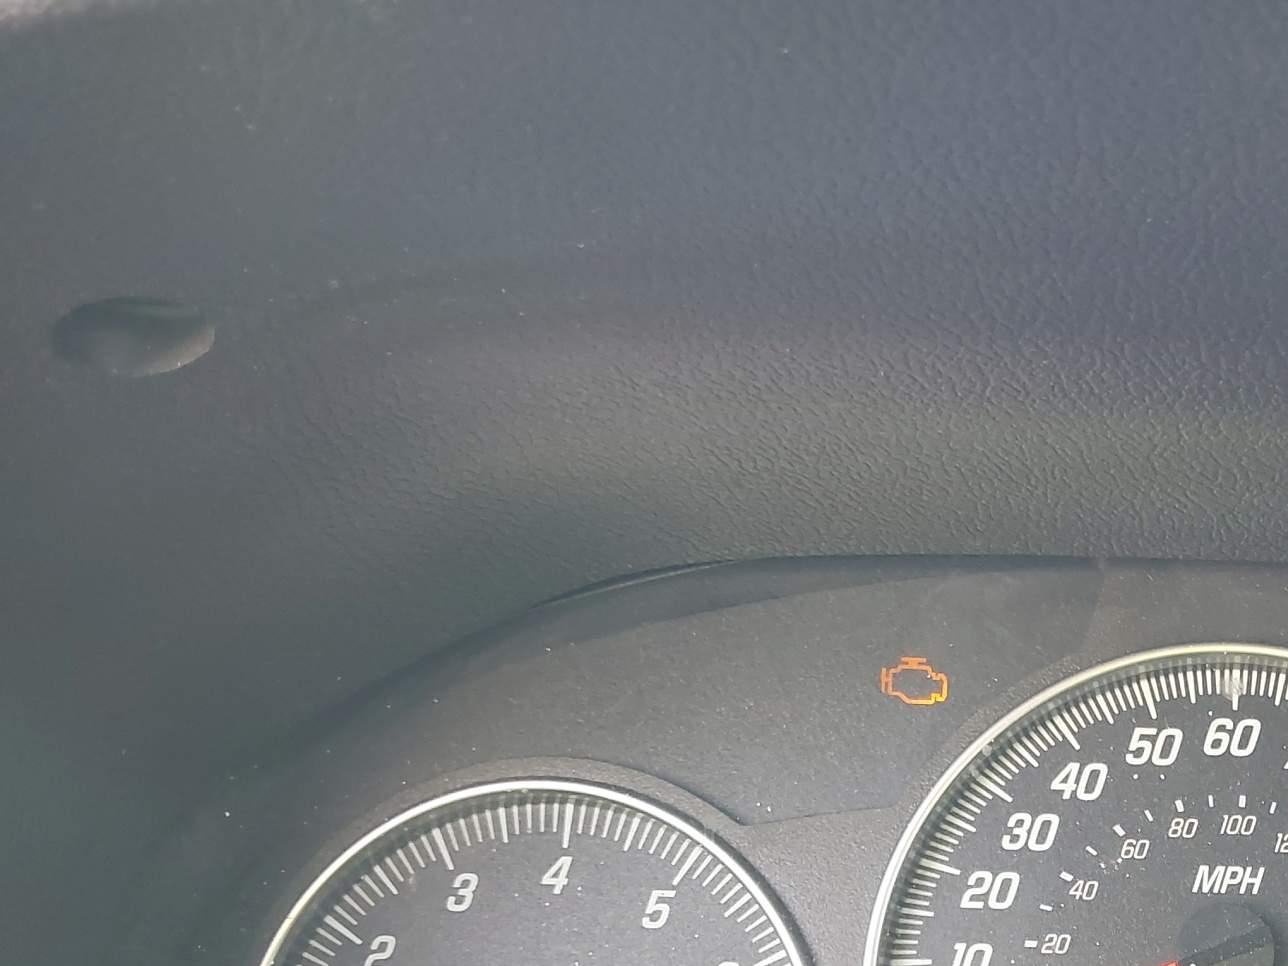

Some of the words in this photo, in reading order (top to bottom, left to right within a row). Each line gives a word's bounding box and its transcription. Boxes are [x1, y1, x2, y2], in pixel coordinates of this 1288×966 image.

[1125, 726, 1184, 766] 50
[1203, 717, 1262, 757] 60
[1050, 761, 1109, 801] 40
[1001, 812, 1060, 852] 30
[1167, 817, 1199, 839] 80
[1220, 814, 1257, 836] 100
[1120, 838, 1150, 860] 60
[446, 872, 479, 912] 3
[540, 856, 573, 895] 4
[959, 870, 1020, 910] 20
[1068, 879, 1099, 901] 40
[1191, 864, 1265, 895] MPH
[641, 889, 677, 929] 5
[1040, 933, 1072, 955] 20
